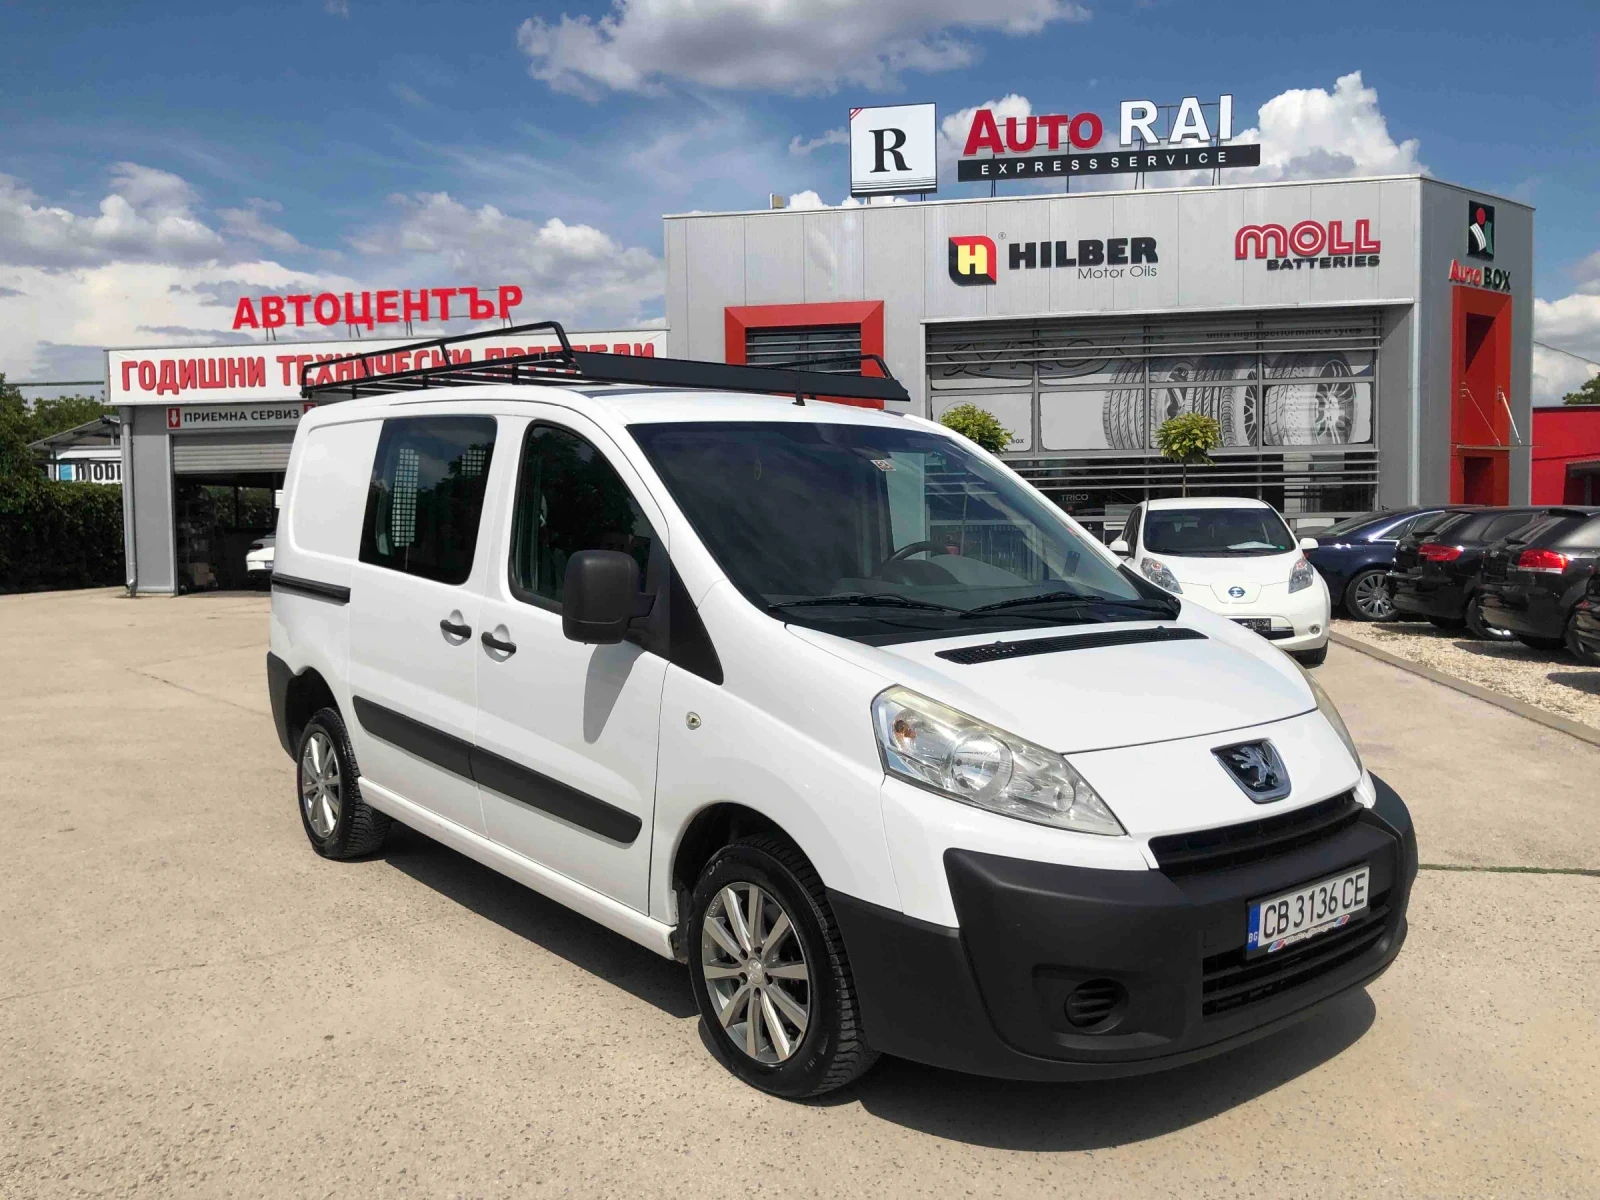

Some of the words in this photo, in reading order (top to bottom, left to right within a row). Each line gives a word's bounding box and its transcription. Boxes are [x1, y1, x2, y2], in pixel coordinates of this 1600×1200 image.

[1119, 93, 1233, 147] RAI
[869, 127, 912, 174] R
[981, 158, 1098, 175] EXPRESS
[1111, 151, 1227, 168] SERVICE
[1008, 236, 1159, 270] HILBER
[1266, 254, 1381, 271] BATTERIES
[1078, 266, 1125, 279] Motor
[1130, 264, 1158, 278] Oils
[232, 285, 523, 331] АВТОЦЕНТЪР
[121, 355, 267, 396] ГОДИШНИ
[184, 411, 248, 423] ПРИЕМНА
[250, 408, 300, 421] СЕРВИЗ
[1061, 493, 1089, 501] TRICO
[1248, 931, 1259, 943] BG
